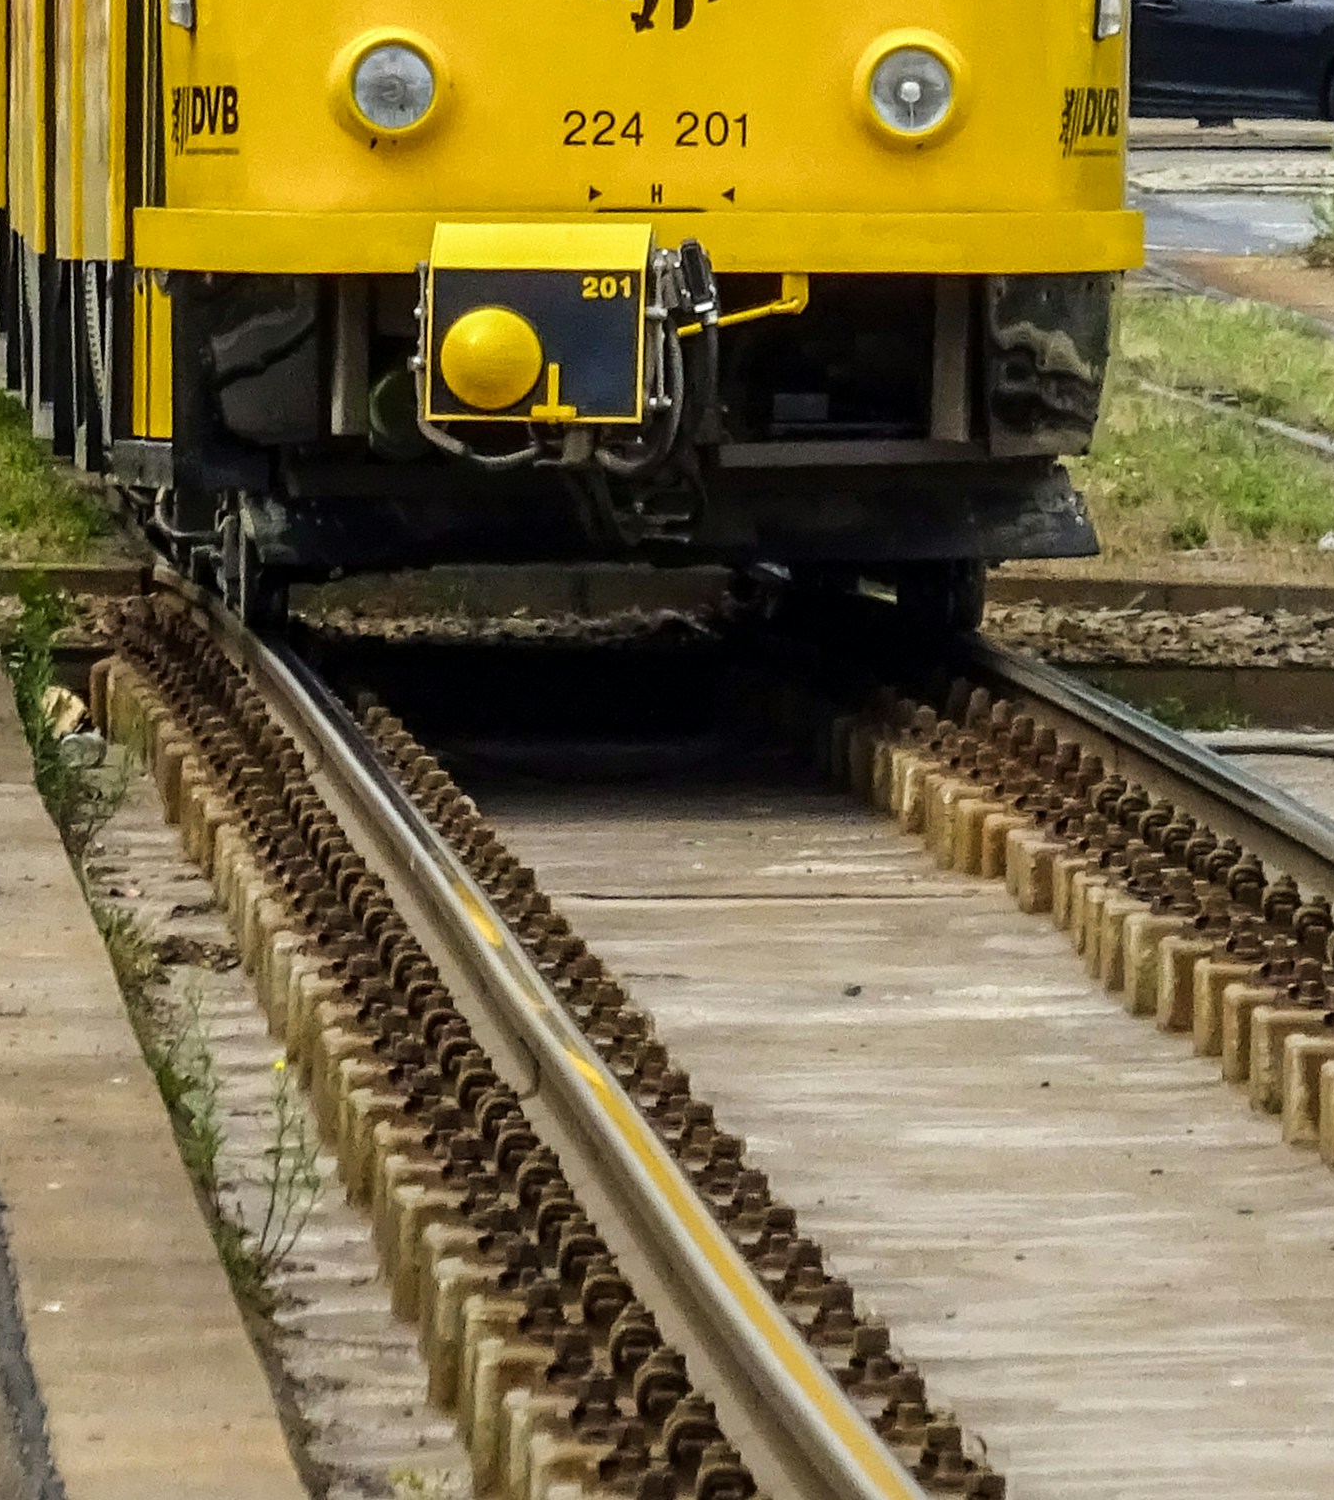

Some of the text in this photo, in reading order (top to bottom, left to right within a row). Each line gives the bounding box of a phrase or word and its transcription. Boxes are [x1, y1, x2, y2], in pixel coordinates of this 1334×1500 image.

[192, 85, 238, 135] DVB
[1082, 88, 1119, 136] DVB
[563, 111, 747, 147] 224 201
[651, 183, 662, 204] H
[583, 276, 631, 299] 201
